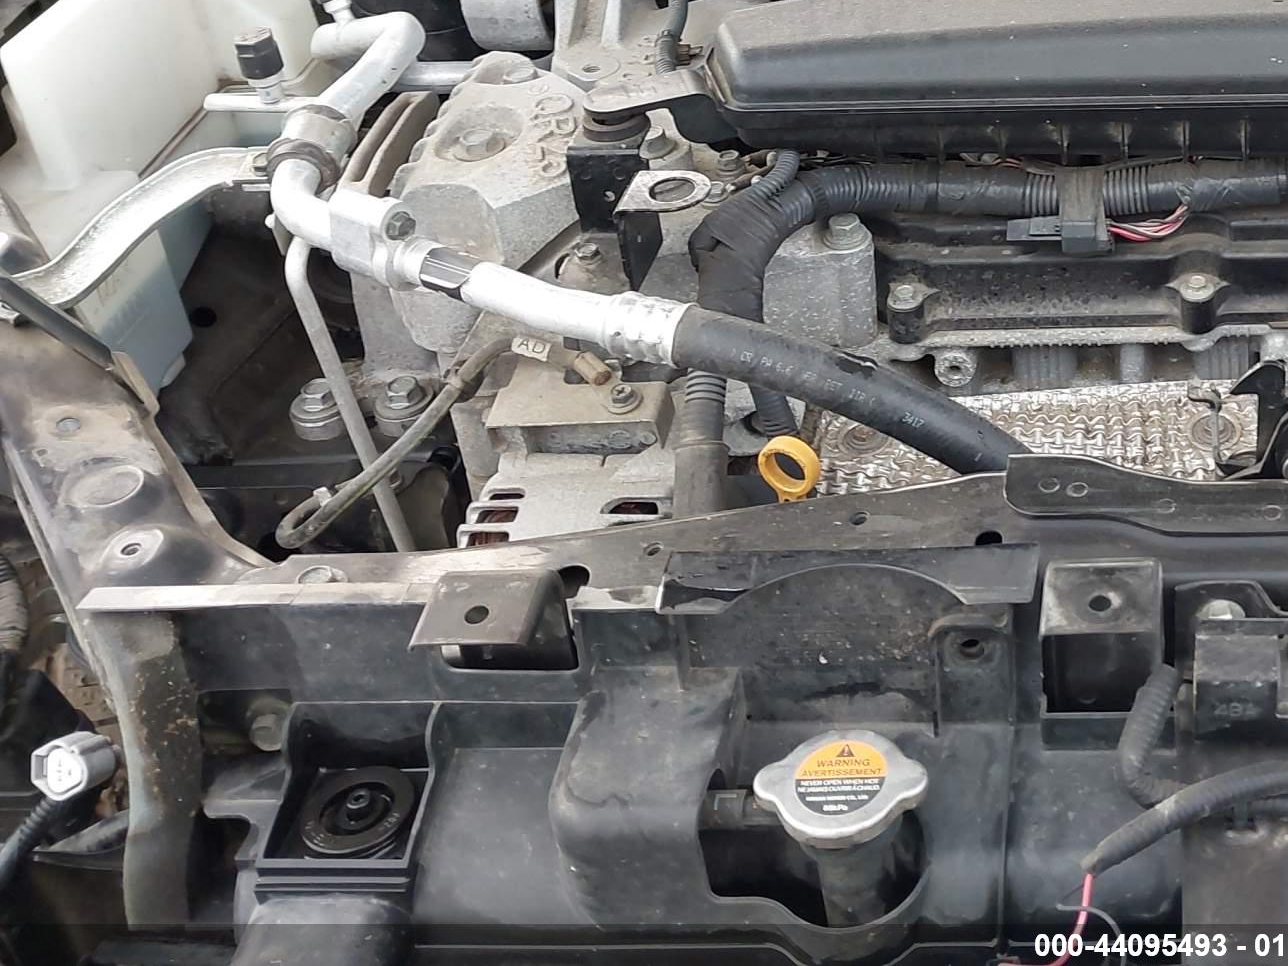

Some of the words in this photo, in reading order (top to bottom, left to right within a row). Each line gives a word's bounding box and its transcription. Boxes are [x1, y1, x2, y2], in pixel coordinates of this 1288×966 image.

[517, 337, 546, 354] AD
[816, 759, 870, 767] WARNING
[801, 768, 883, 777] AVERTISSEMENT
